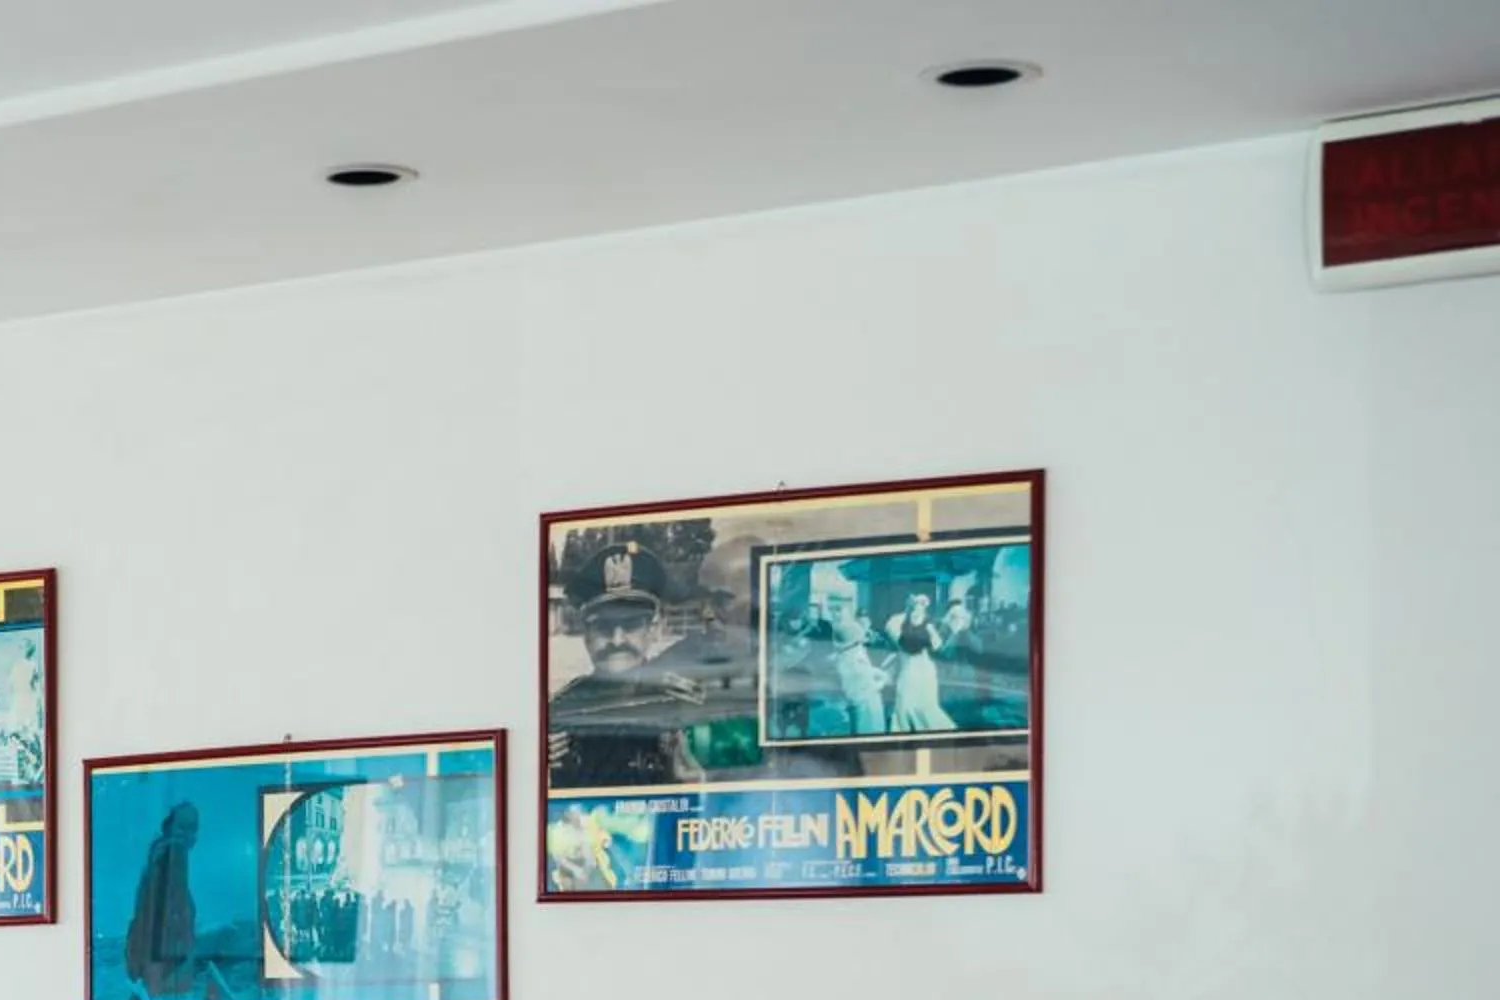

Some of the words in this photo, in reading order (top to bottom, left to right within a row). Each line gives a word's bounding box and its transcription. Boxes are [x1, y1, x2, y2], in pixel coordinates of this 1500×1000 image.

[677, 815, 756, 852] FEDERICO
[758, 812, 829, 848] FELLINI
[835, 785, 1017, 859] AMARCORD
